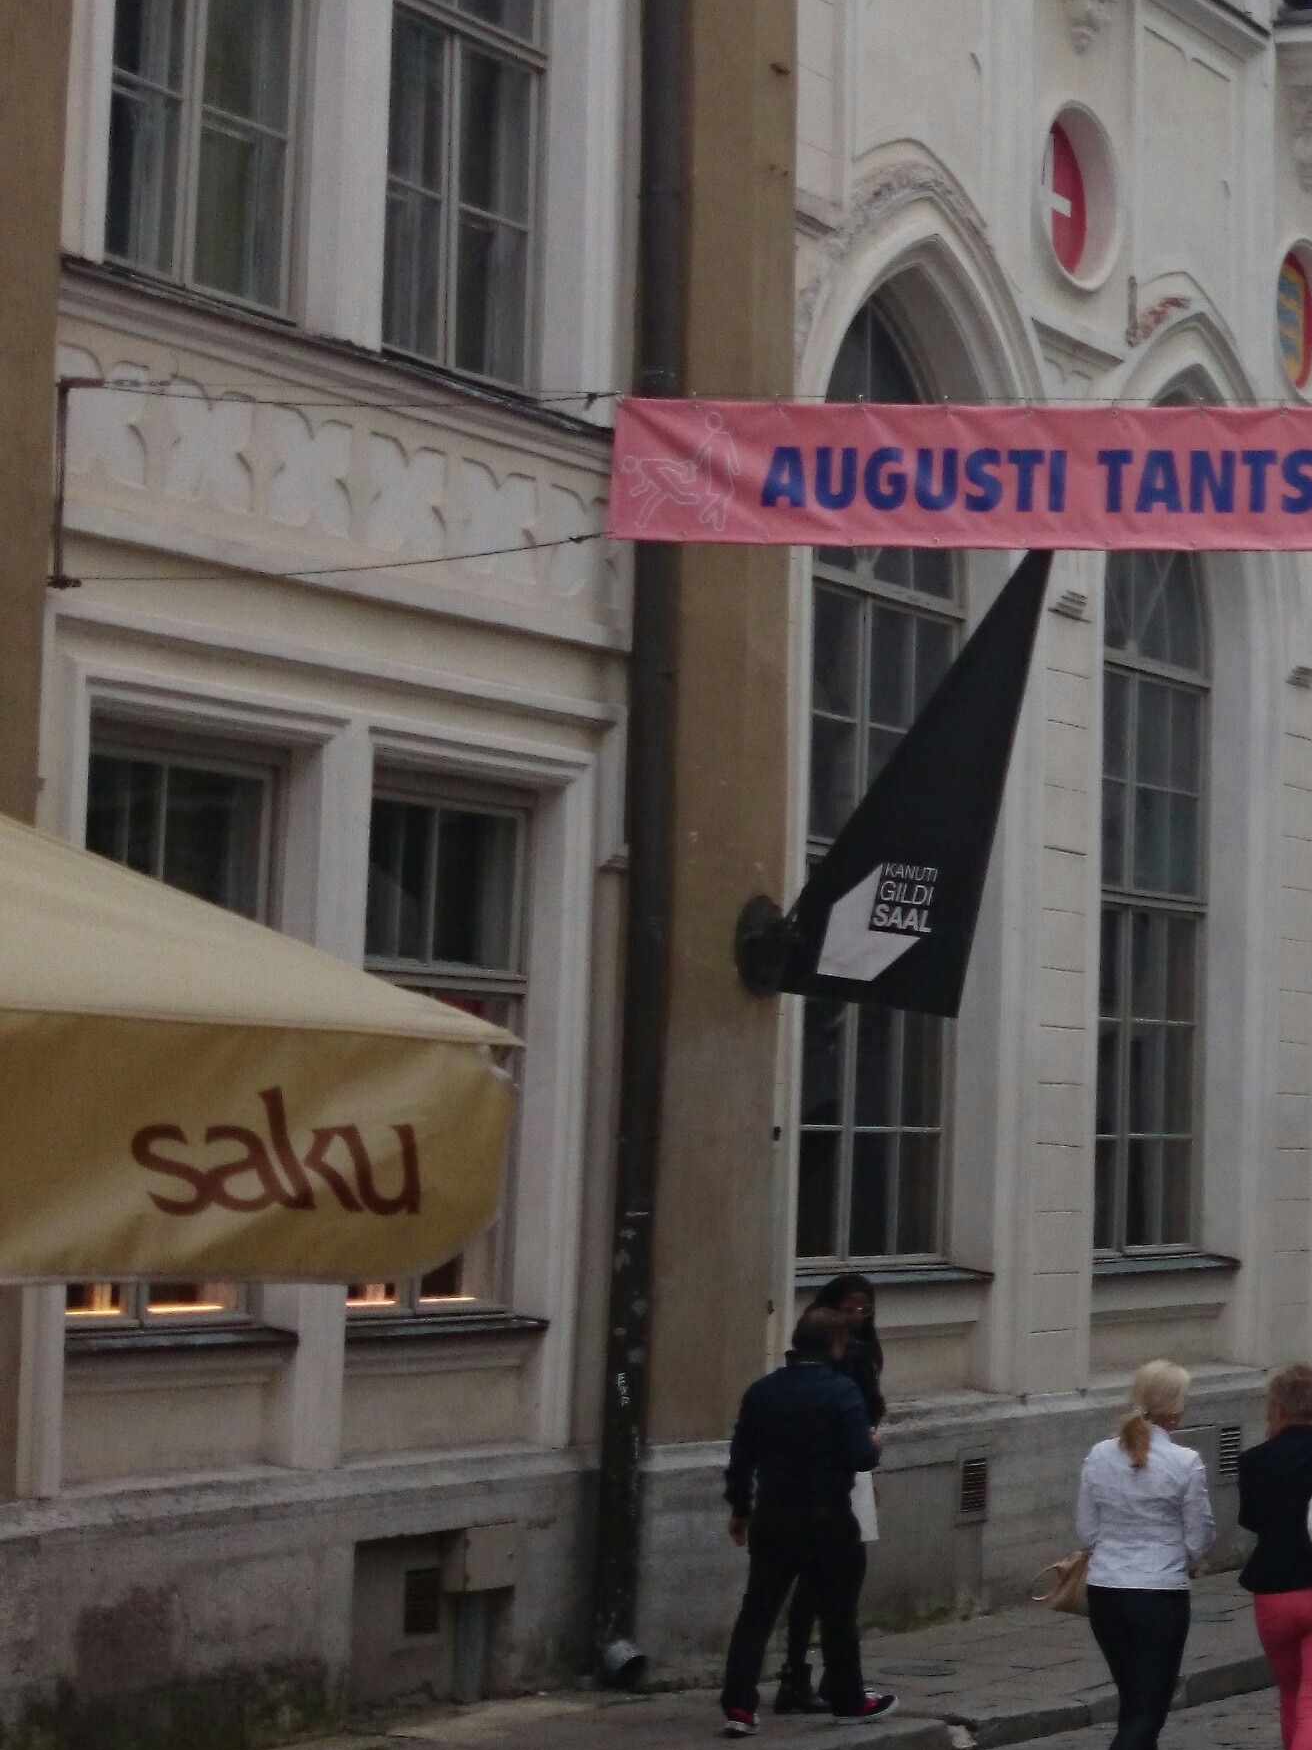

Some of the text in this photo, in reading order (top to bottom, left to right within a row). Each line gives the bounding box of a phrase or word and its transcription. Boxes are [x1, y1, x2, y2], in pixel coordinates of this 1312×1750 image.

[760, 446, 1066, 511] AUGUSTI
[884, 863, 938, 883] KANUTI
[880, 881, 935, 907] GILDI
[872, 904, 932, 933] SAAL
[131, 1085, 422, 1216] saku
